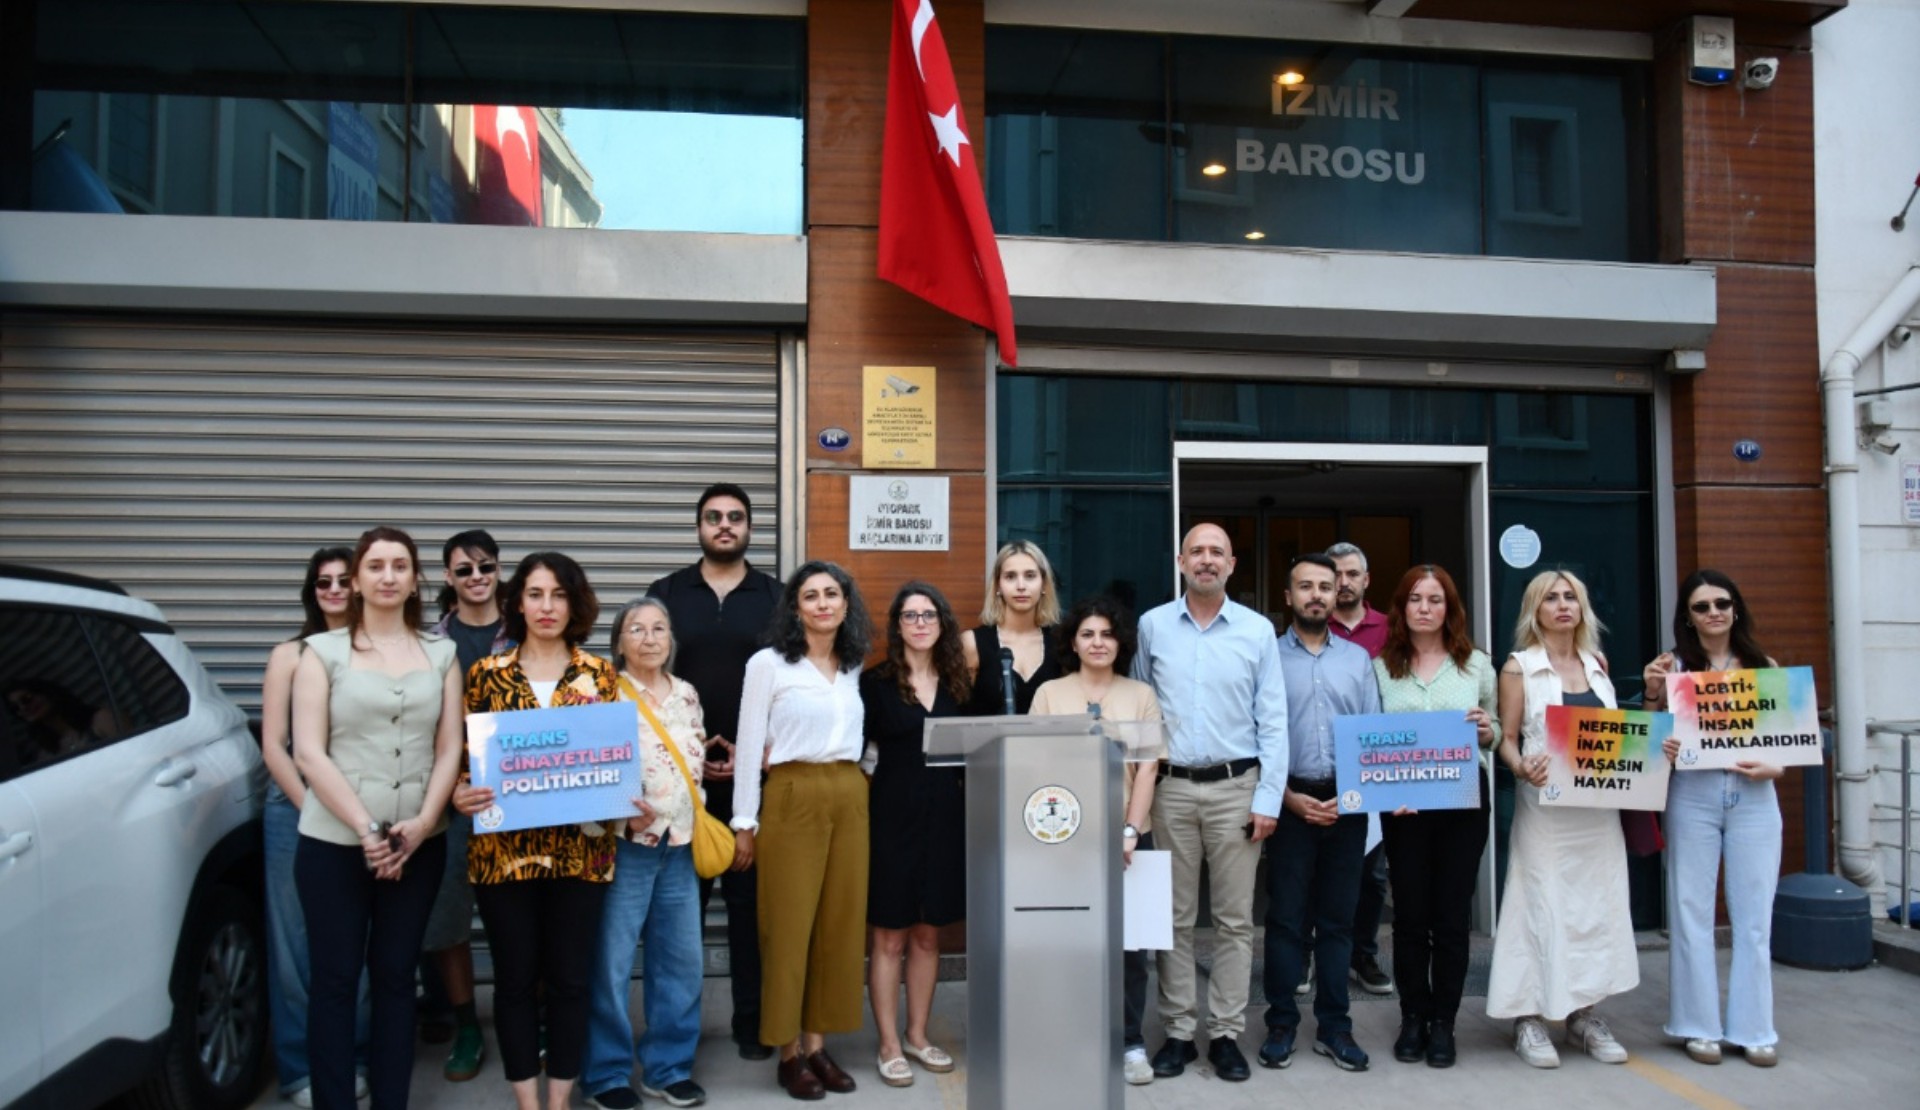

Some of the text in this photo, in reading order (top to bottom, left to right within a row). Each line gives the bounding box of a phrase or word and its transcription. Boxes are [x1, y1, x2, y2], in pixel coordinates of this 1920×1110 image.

[1271, 74, 1400, 121] İZMİR
[1236, 138, 1425, 185] BAROSU
[895, 518, 932, 530] BAROSU
[1695, 678, 1755, 695] LGBTİ+
[1697, 699, 1777, 713] HAKLARI
[1579, 720, 1648, 736] NEFRETE
[1698, 716, 1754, 731] İNSAN
[500, 729, 569, 750] TRANS
[1359, 731, 1417, 747] TRANS
[1577, 735, 1614, 751] İNAT
[1701, 734, 1817, 749] HAKLARIDIR!
[501, 742, 633, 772] CİNAYETLERİ
[1360, 744, 1472, 765] CİNAYETLERİ
[1576, 757, 1643, 773] YAŞASIN
[502, 767, 621, 795] POLİTİKTİR!
[1361, 764, 1461, 784] POLİTİKTİR!
[1574, 776, 1631, 790] HAYAT!
